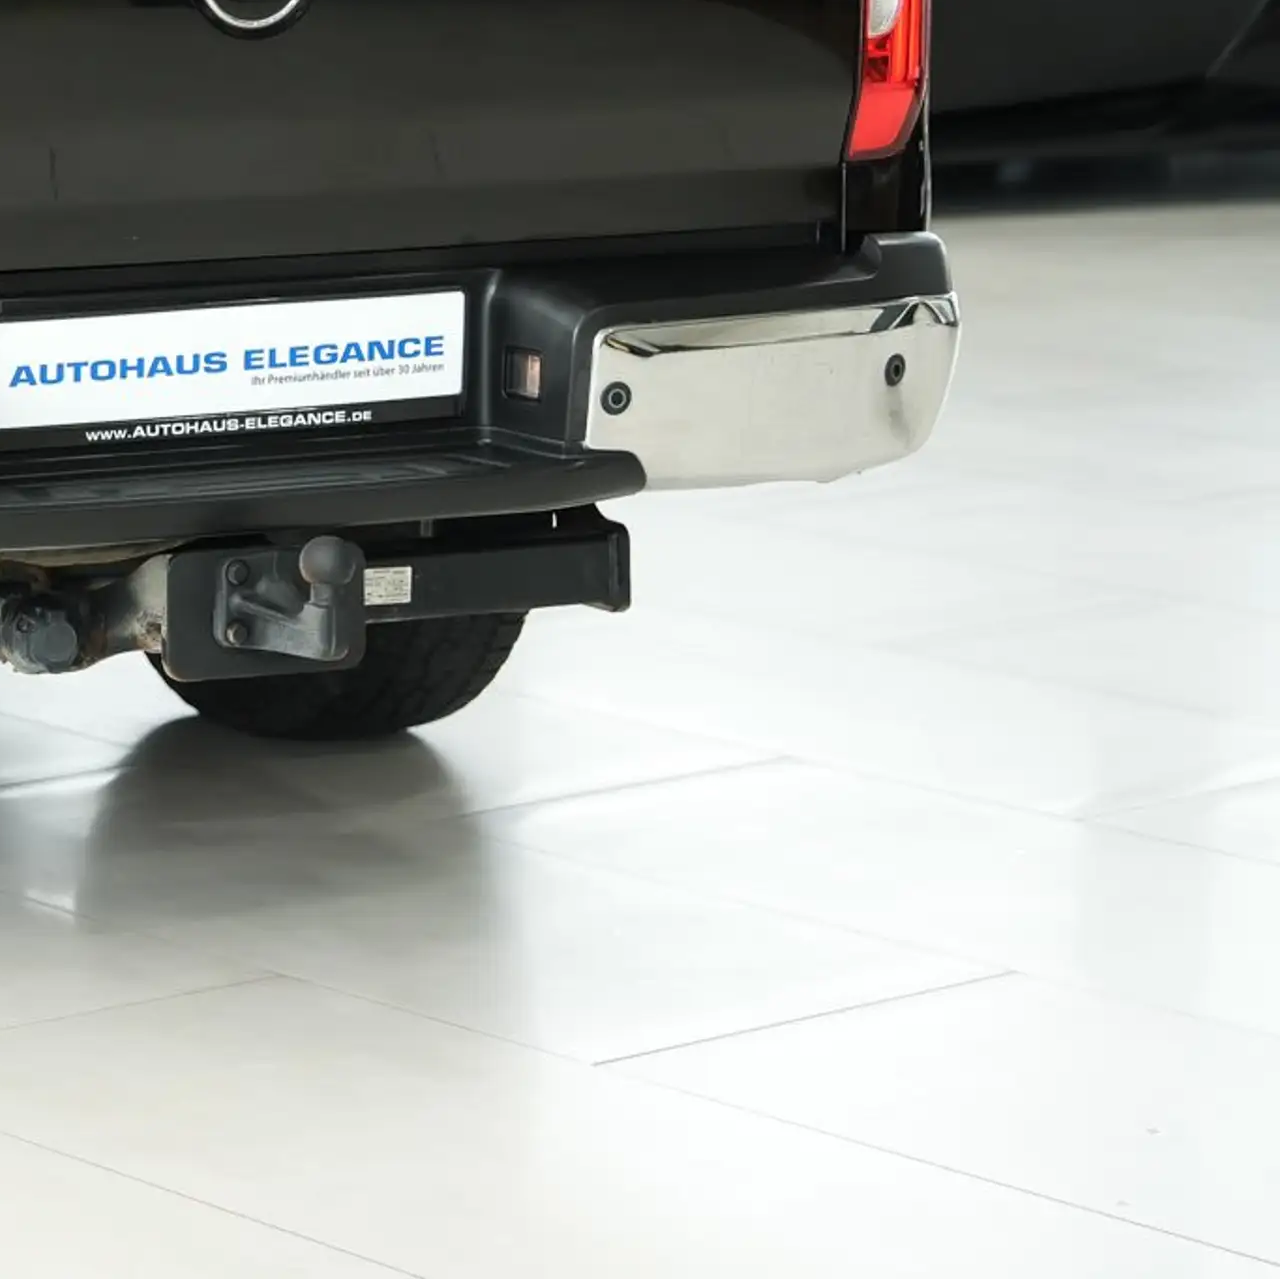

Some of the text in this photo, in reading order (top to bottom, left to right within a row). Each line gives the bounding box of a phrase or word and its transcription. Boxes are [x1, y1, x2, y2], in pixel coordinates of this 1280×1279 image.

[9, 335, 444, 387] AUTOHAUS ELEGANCE
[251, 375, 265, 386] Ihr
[267, 369, 351, 385] Premiumhändler
[353, 367, 370, 379] seit
[373, 364, 395, 377] über
[411, 362, 445, 374] Jahren
